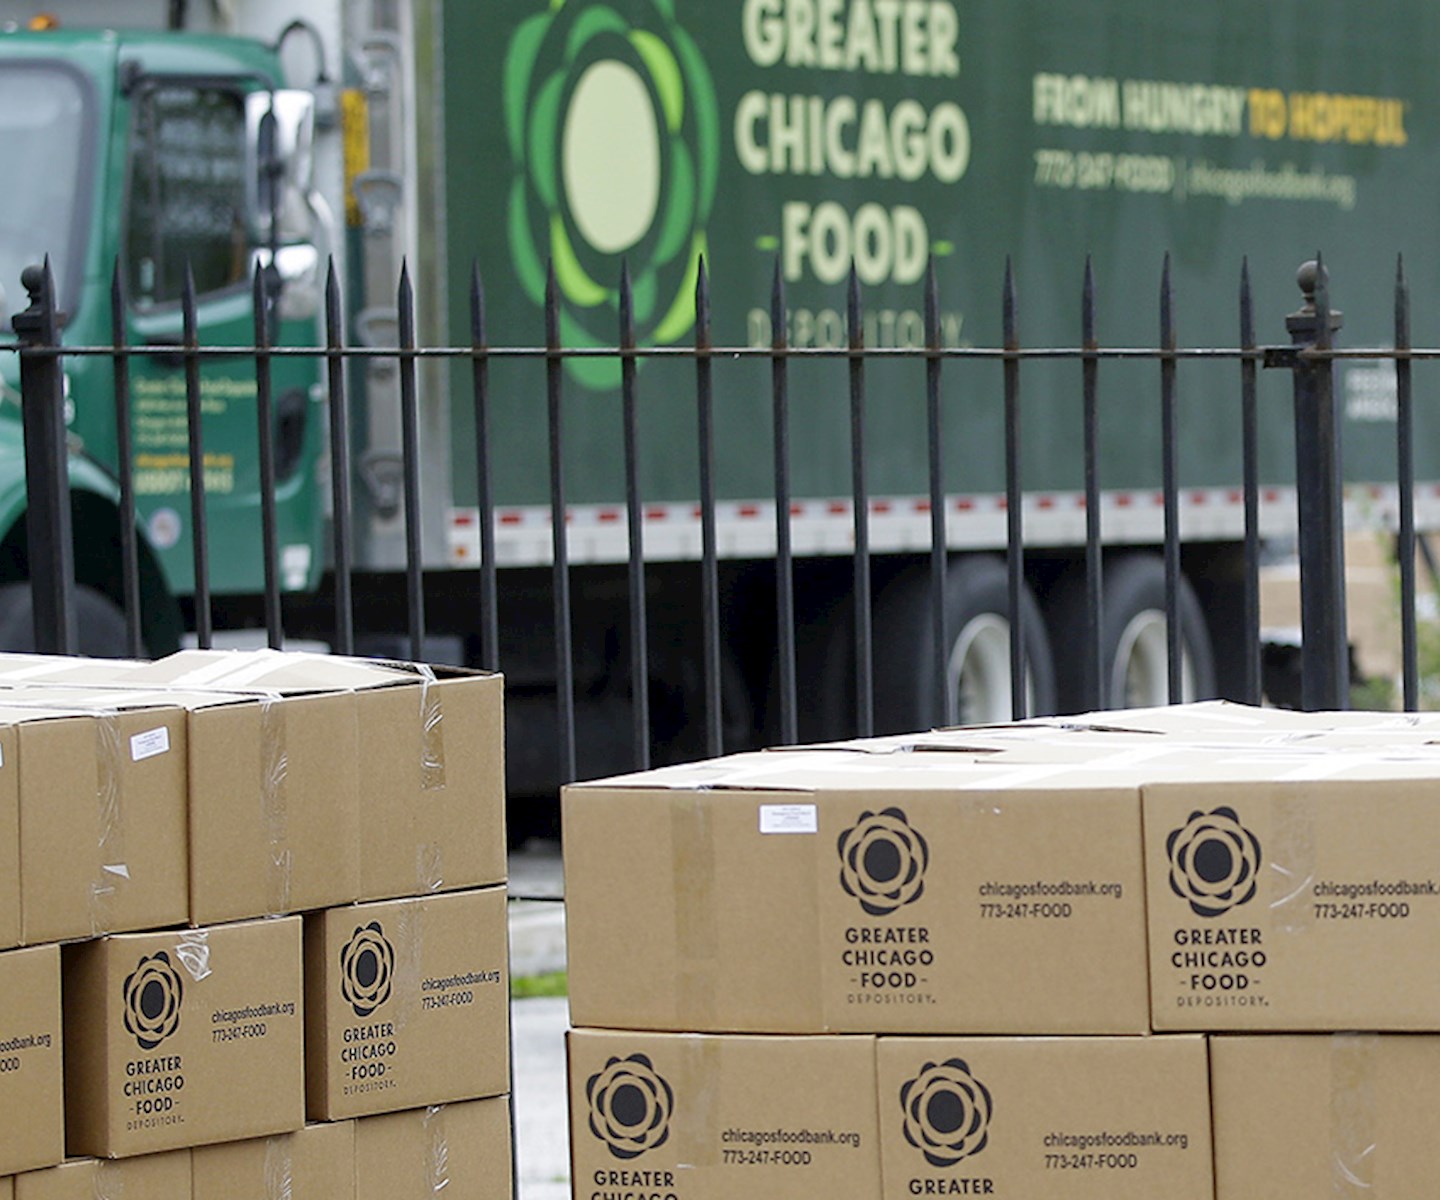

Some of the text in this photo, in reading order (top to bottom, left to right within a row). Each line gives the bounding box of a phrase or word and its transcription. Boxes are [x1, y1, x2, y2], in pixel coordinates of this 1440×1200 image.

[743, 0, 960, 77] GREATER
[1033, 72, 1119, 128] FROM
[1122, 79, 1244, 136] HUNGRY
[1247, 88, 1287, 139] TO
[734, 90, 971, 183] CHICAGO
[979, 881, 1122, 899] chicagosfoodbank.org
[980, 904, 1071, 918] 773-247-FOOD
[1314, 903, 1410, 919] 773-247-FOOD
[845, 928, 929, 944] GREATER
[1174, 929, 1262, 946] GREATER
[842, 950, 934, 966] CHICAGO
[1172, 951, 1267, 968] CHICAGO
[343, 1022, 394, 1043] GREATER
[341, 1041, 396, 1063] CHICAGO
[126, 1056, 182, 1076] GREATER
[123, 1075, 184, 1097] CHICAGO
[722, 1127, 860, 1147] chicagosfoodbank.org
[1043, 1131, 1188, 1149] chicagosfoodbank.org
[722, 1150, 811, 1165] 773-247-FOOD
[1045, 1153, 1138, 1169] 773-247-FOOD
[594, 1170, 674, 1187] GREATER
[909, 1178, 994, 1195] GREATER
